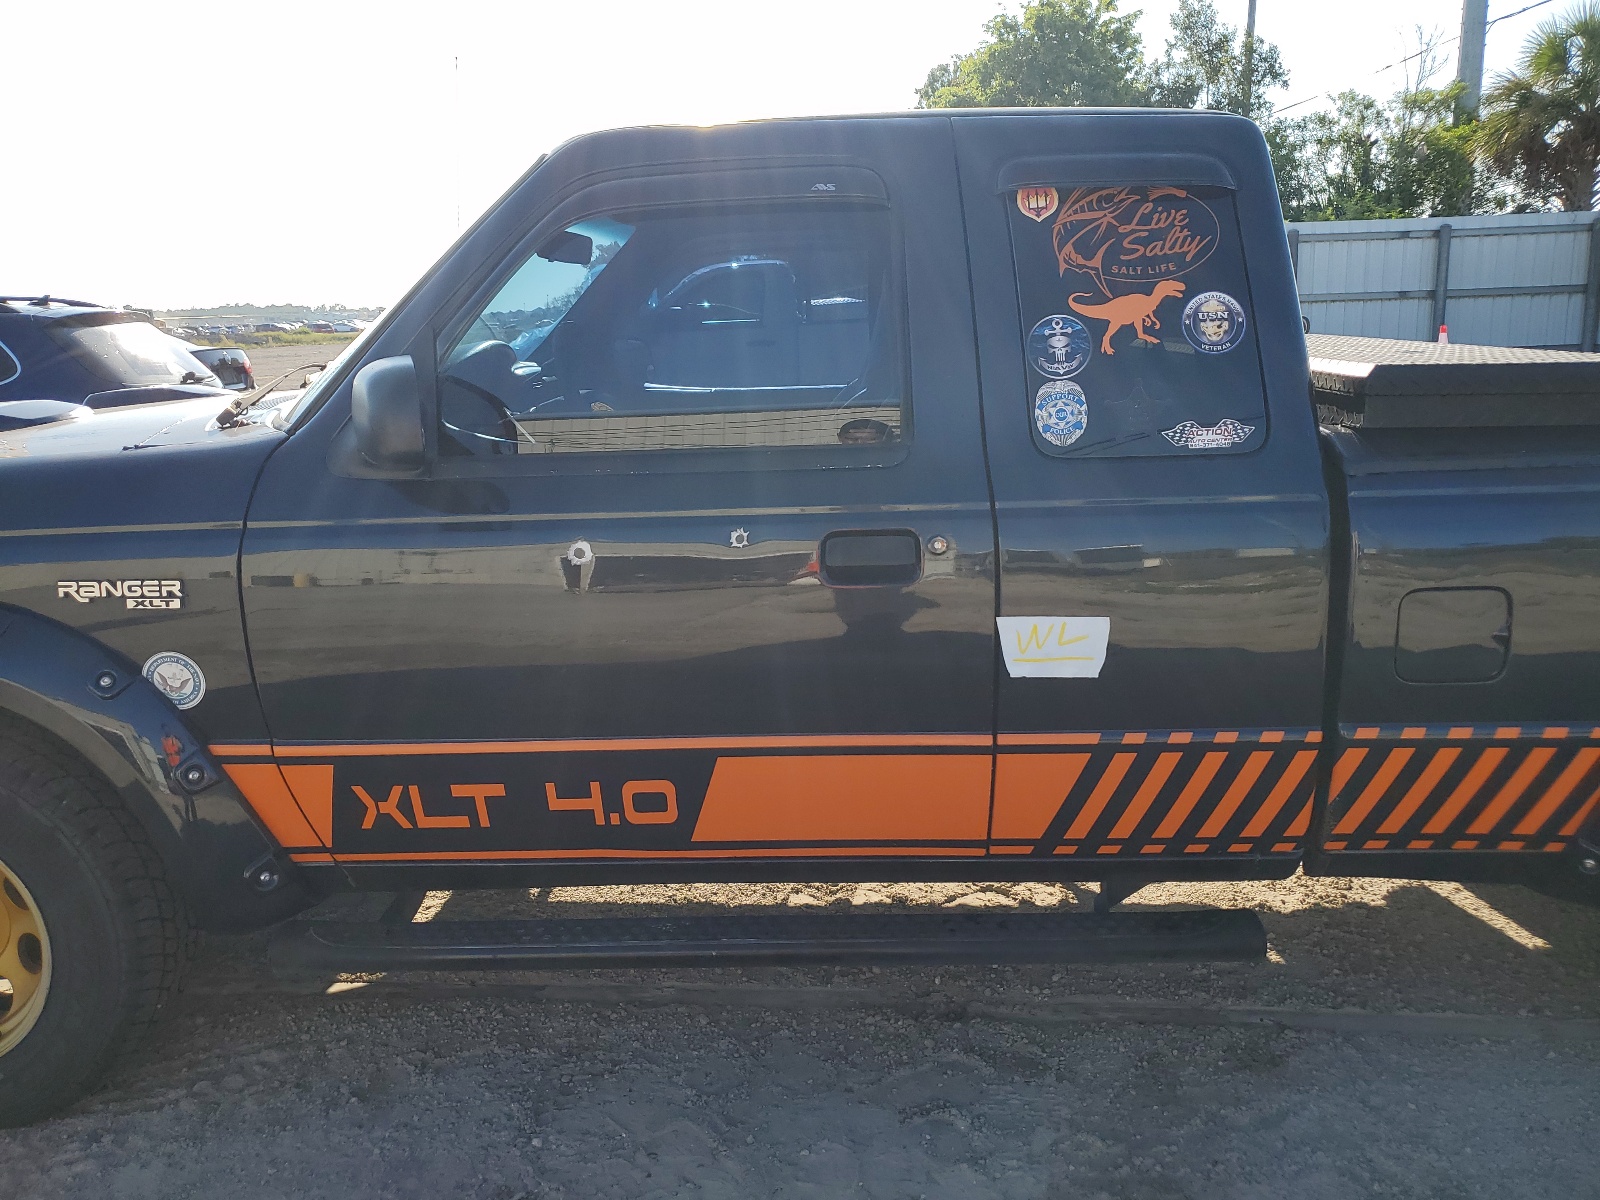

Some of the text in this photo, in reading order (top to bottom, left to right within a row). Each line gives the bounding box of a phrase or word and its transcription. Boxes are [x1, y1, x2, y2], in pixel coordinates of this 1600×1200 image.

[1118, 202, 1190, 233] Live
[1120, 226, 1212, 262] Salty
[1111, 262, 1177, 275] SALT LIFE
[1186, 293, 1241, 316] UNITED STATES NAVY
[1197, 311, 1230, 321] USN
[1201, 341, 1231, 351] VETERAN
[1047, 363, 1075, 371] NAVY
[1041, 393, 1079, 406] SUPPORT
[1049, 426, 1075, 435] POLICE
[1187, 427, 1232, 437] ACTION
[57, 580, 183, 603] RANGER
[132, 600, 175, 608] XLT
[150, 657, 177, 672] DEPARTMENT
[350, 779, 679, 830] XLT 4.0
